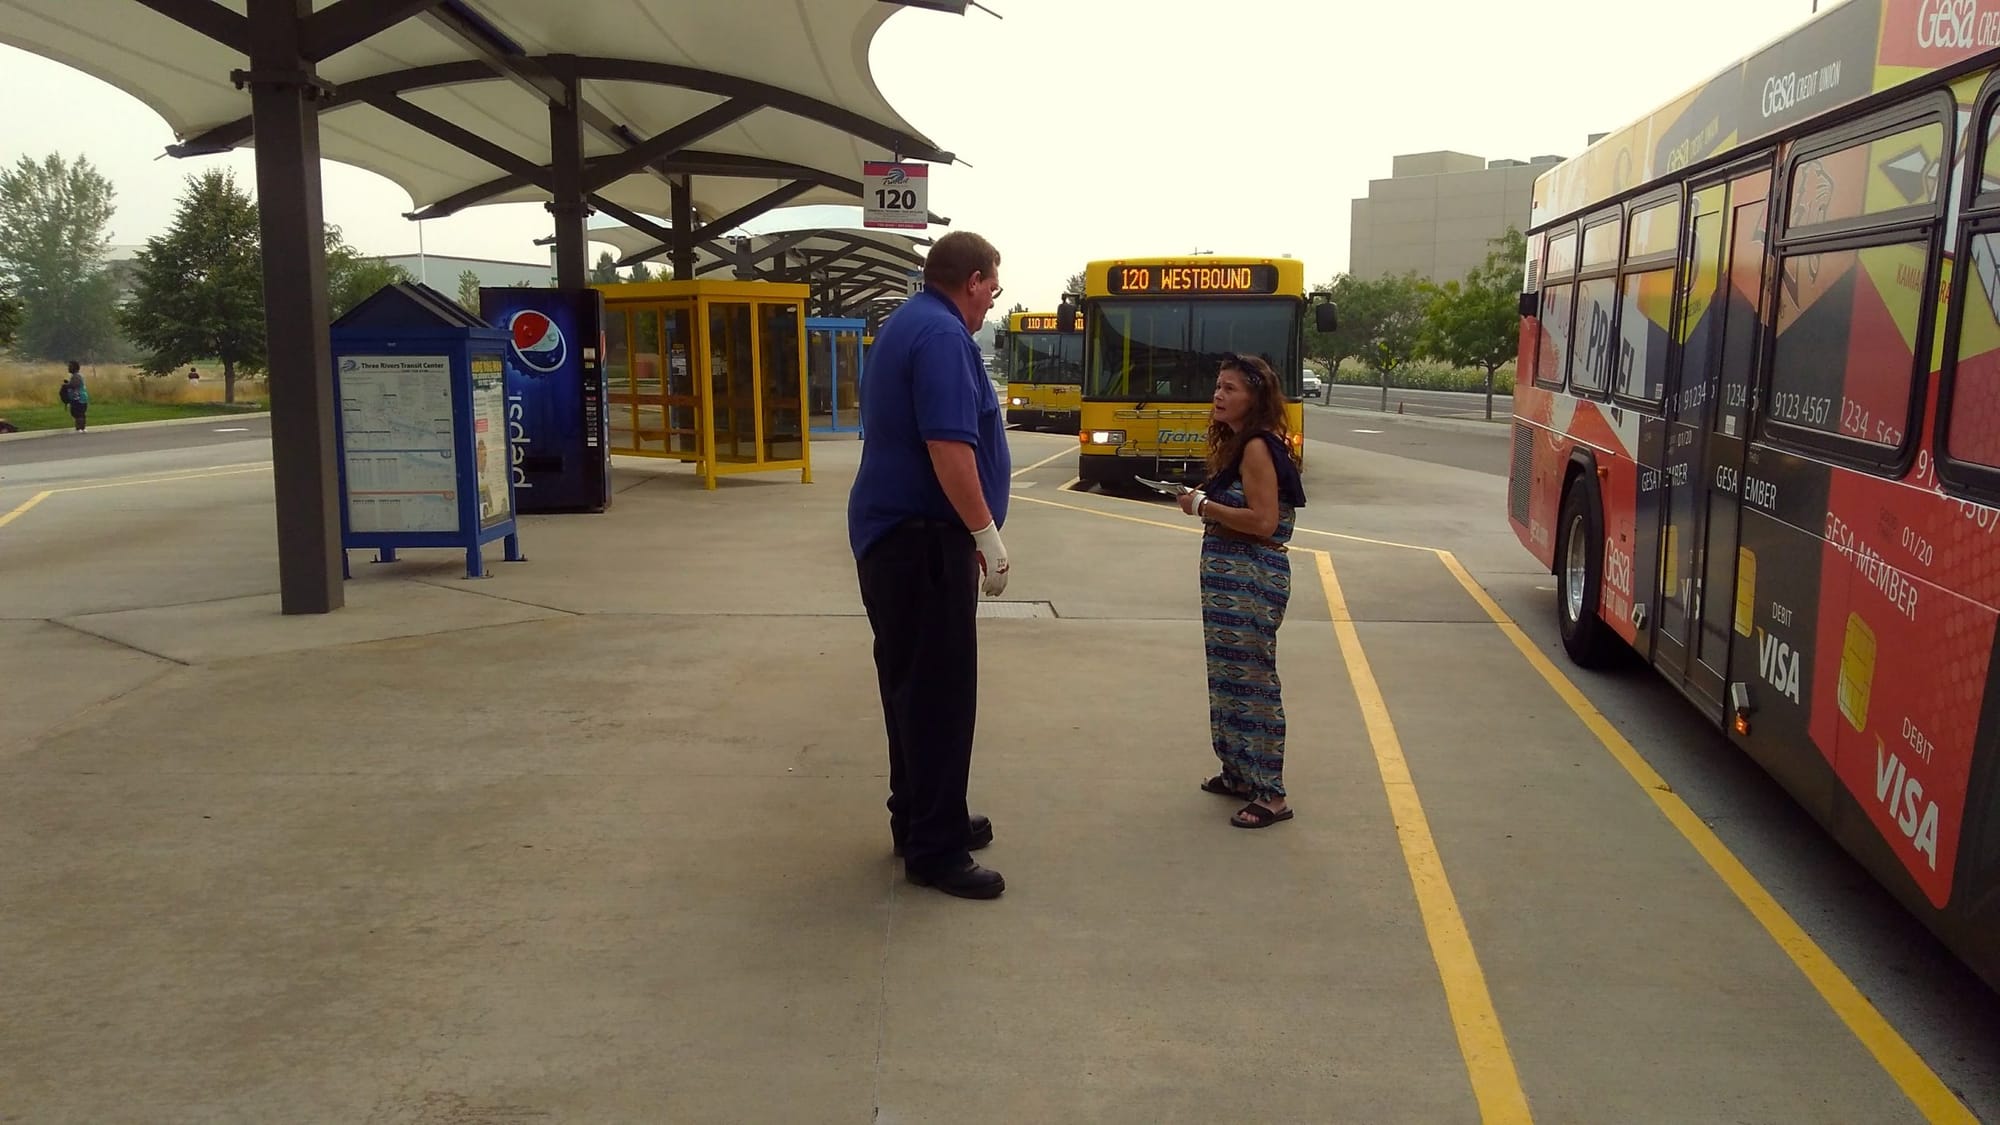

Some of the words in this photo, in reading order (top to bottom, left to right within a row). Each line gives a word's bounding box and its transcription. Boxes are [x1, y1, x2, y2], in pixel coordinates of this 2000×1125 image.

[1917, 0, 1977, 49] Gesa
[1762, 72, 1796, 118] Gesa
[1796, 70, 1819, 102] CREDIT
[1819, 60, 1842, 93] UNION
[875, 189, 917, 210] 120
[912, 282, 923, 291] 11
[1121, 269, 1149, 290] 120
[1161, 268, 1251, 289] WESTBOUND
[1027, 318, 1041, 329] 110
[361, 362, 380, 370] Three
[380, 362, 400, 370] Rivers
[400, 362, 423, 370] Transit
[423, 362, 444, 370] Center
[1775, 391, 1801, 420] 9123
[1801, 397, 1832, 425] 4567
[1839, 396, 1869, 438] 1234
[1157, 428, 1210, 444] Trans
[1716, 465, 1738, 493] GESA
[1744, 476, 1778, 511] EMBER
[1605, 536, 1630, 597] Gesa
[1825, 511, 1854, 562] GESA
[1856, 541, 1918, 622] MEMBER
[1902, 526, 1933, 567] 01/20
[1772, 602, 1793, 628] DEBIT
[1755, 625, 1800, 705] VISA
[1902, 716, 1935, 766] DEBIT
[1874, 731, 1939, 872] VISA
